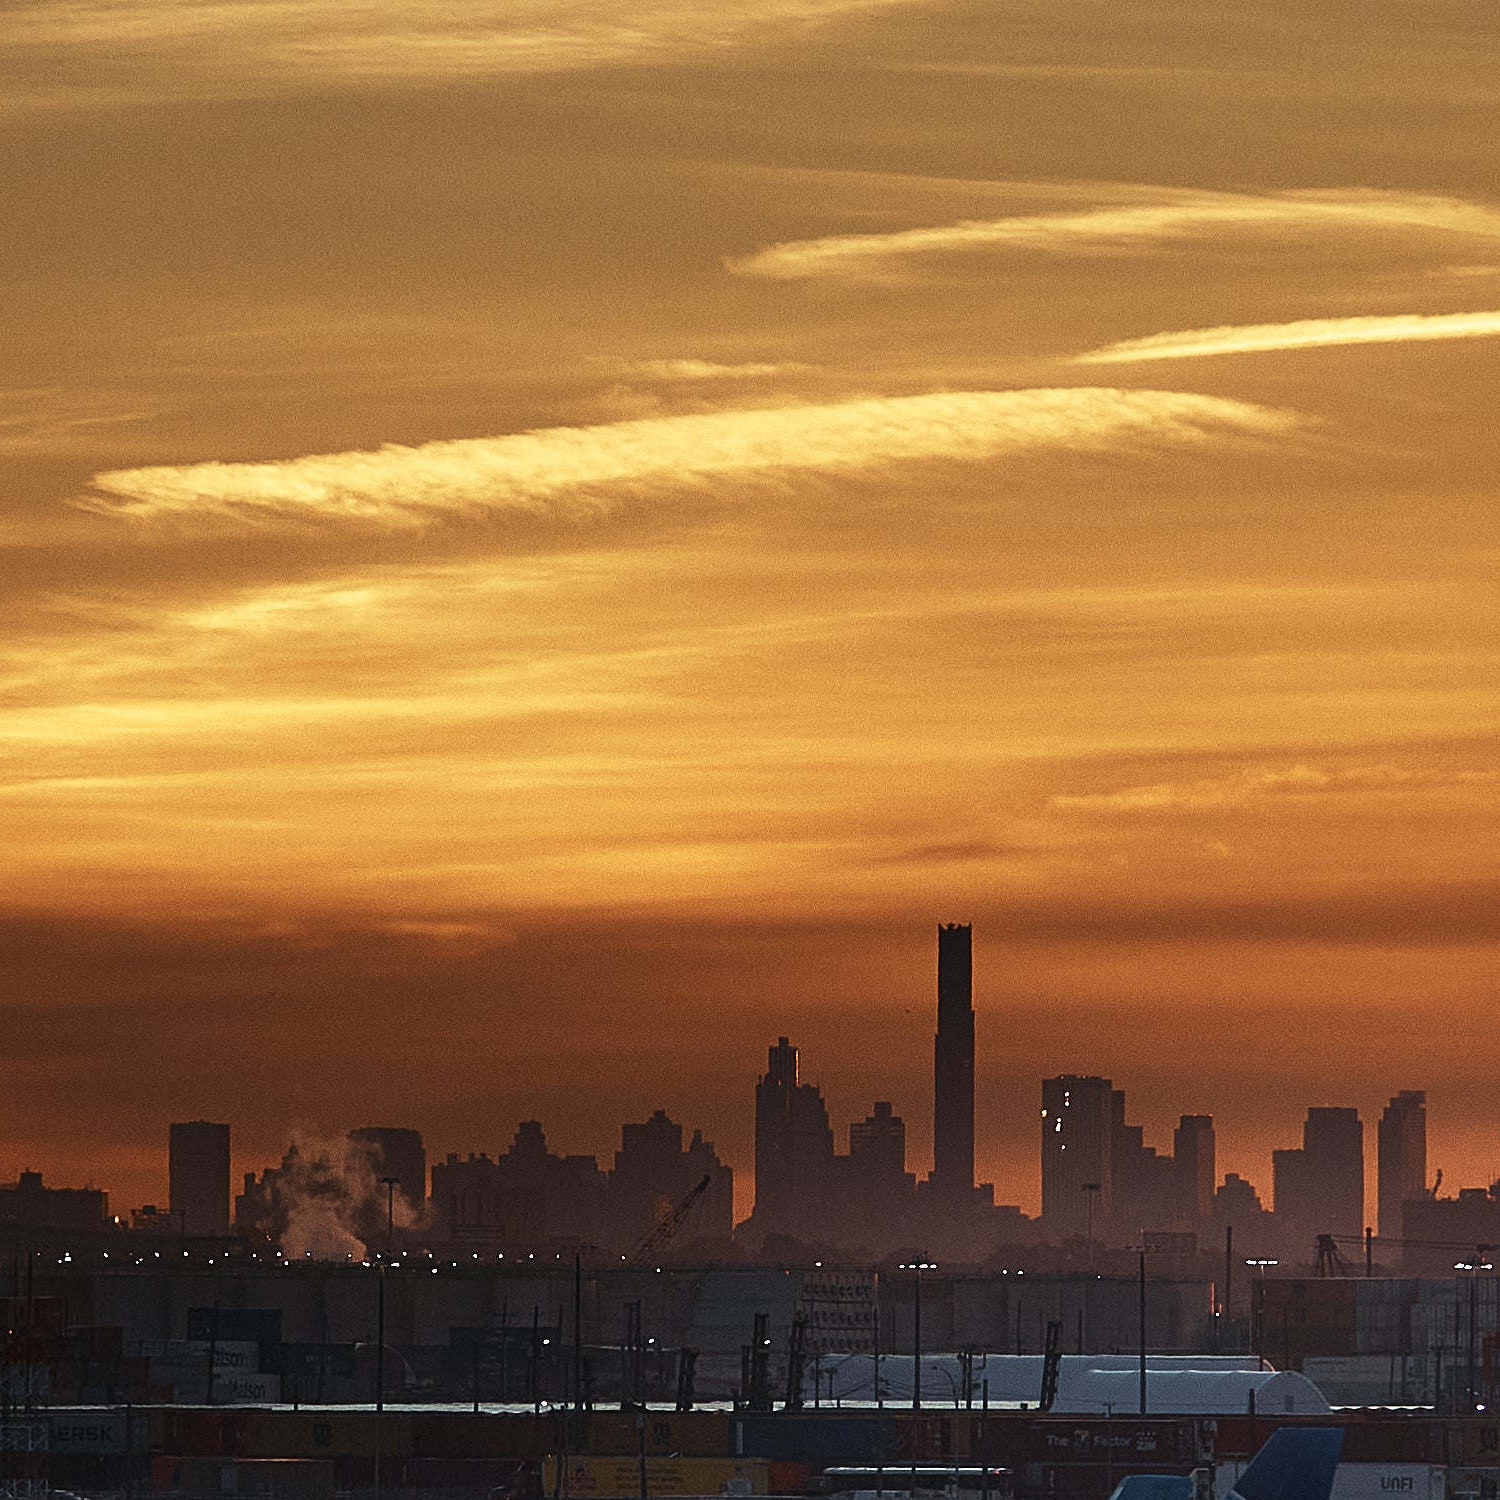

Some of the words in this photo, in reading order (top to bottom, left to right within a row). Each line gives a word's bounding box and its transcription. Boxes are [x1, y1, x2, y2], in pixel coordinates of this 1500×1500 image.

[49, 1426, 114, 1442] AERSK
[1046, 1435, 1069, 1446] The
[1094, 1435, 1131, 1447] Factor
